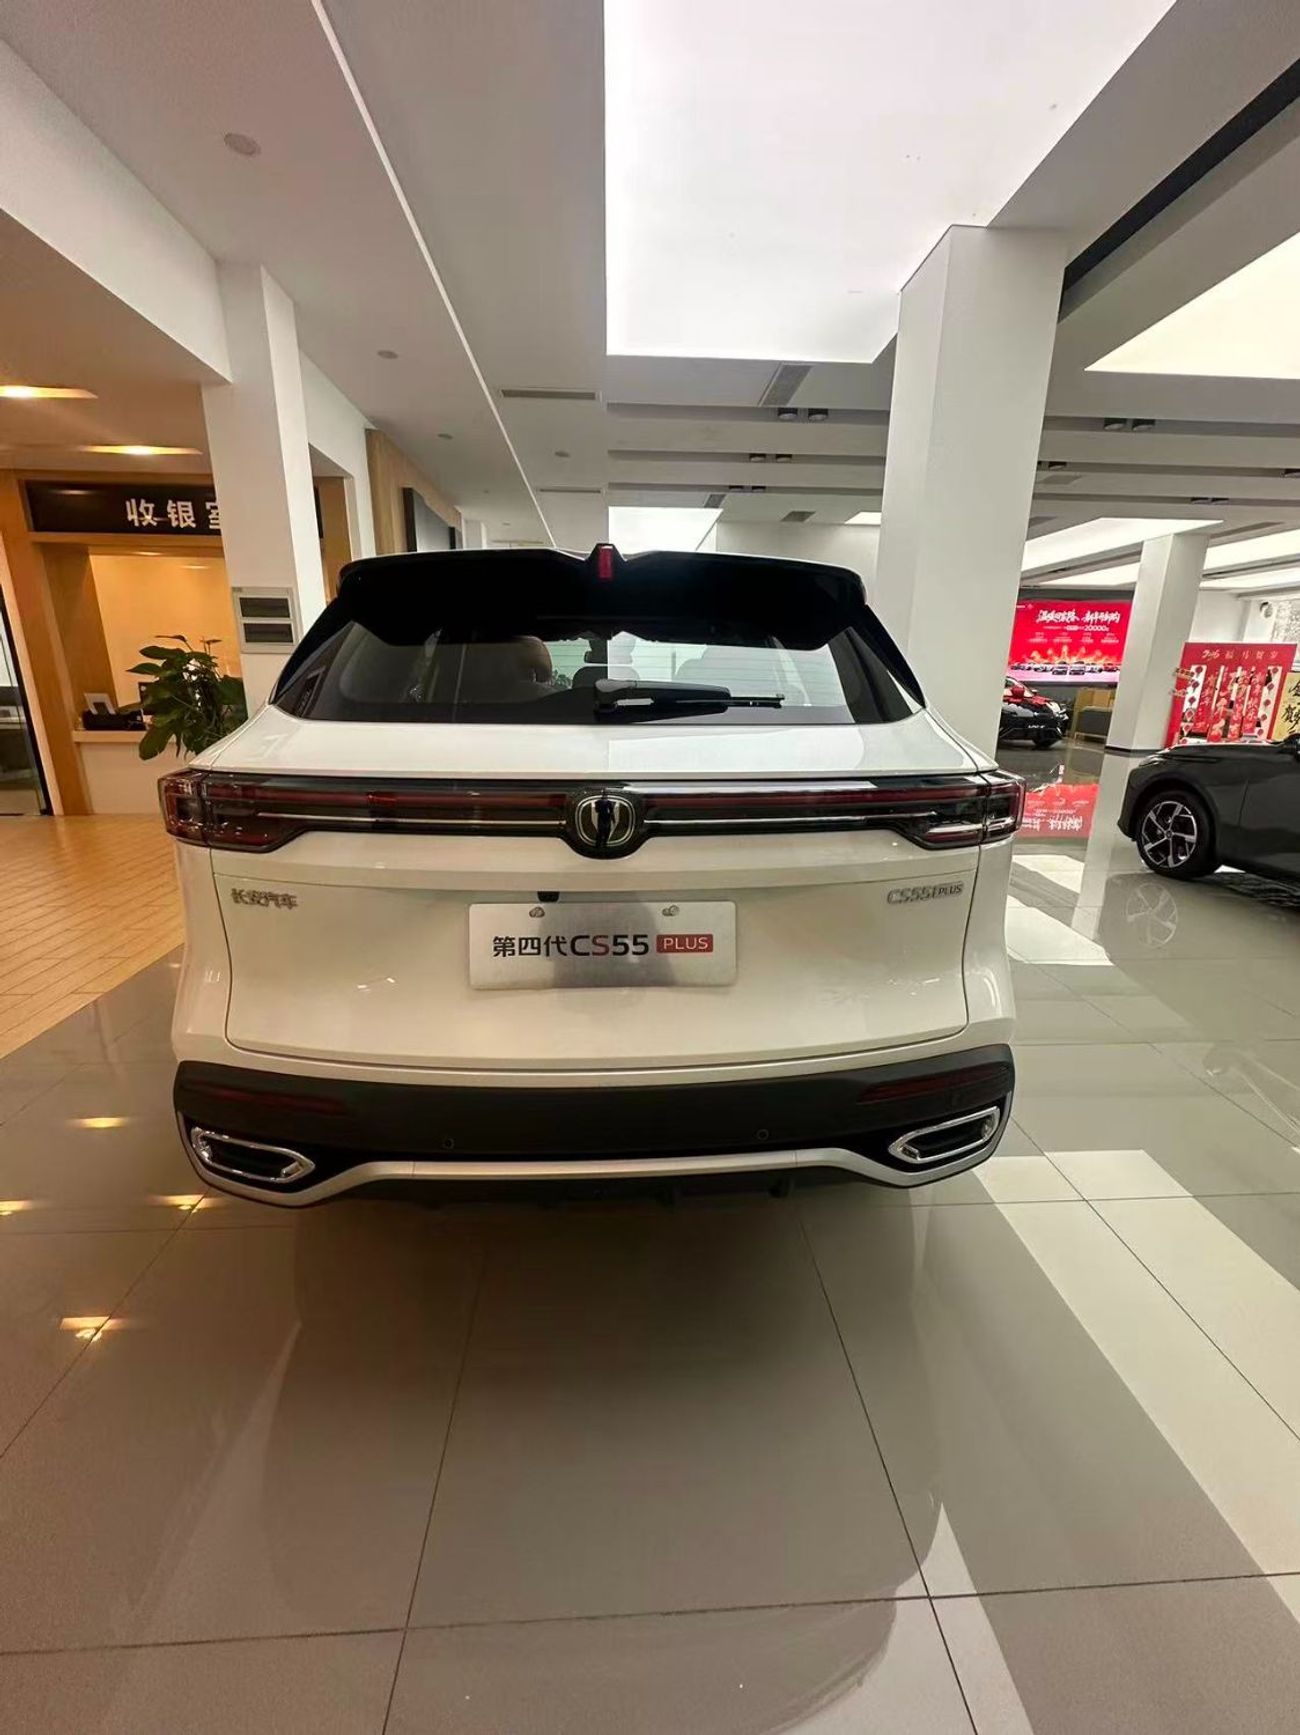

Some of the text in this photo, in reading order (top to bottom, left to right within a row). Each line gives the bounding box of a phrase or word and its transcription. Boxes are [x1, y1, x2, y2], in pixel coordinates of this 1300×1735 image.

[231, 887, 299, 910] 长安汽车
[492, 934, 708, 957] 第四代CS55 PLUS
